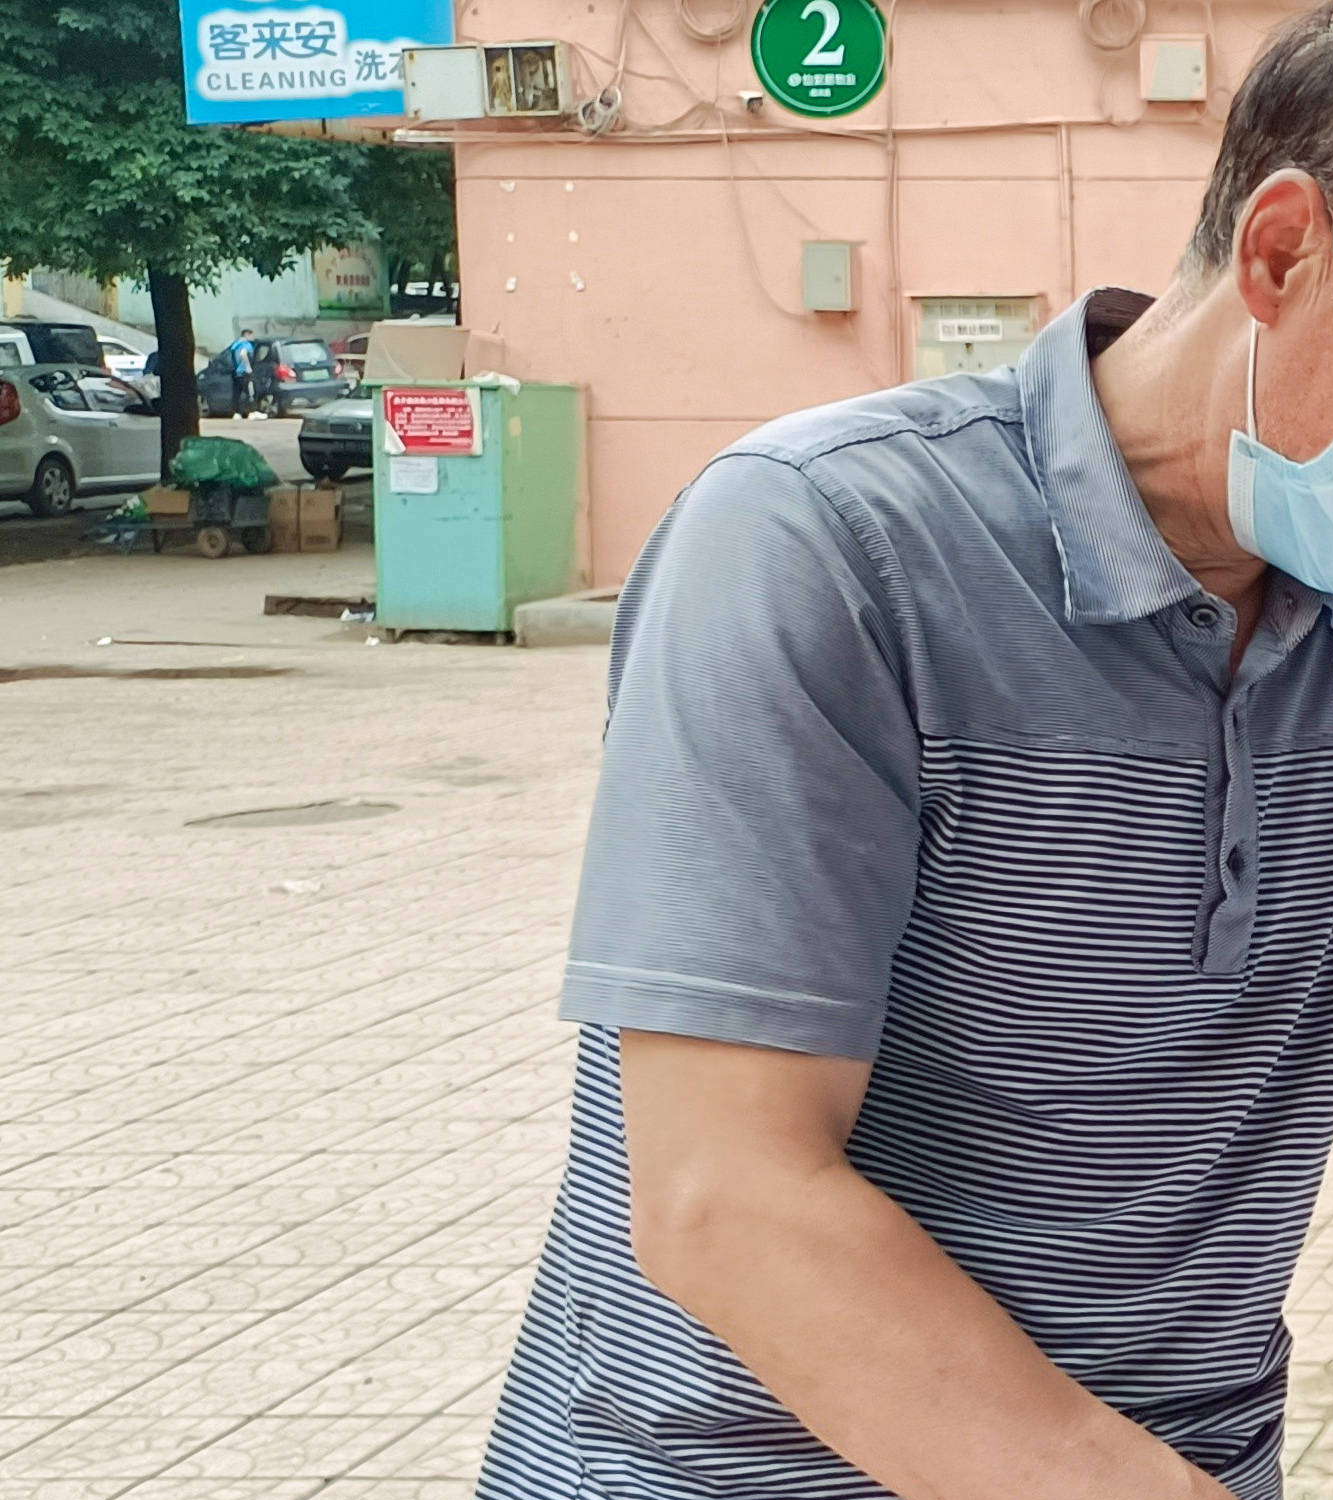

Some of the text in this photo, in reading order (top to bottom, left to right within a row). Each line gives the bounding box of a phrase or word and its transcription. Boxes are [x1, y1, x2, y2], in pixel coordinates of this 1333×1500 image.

[208, 18, 338, 61] 客来安
[800, 0, 844, 66] 2
[206, 69, 347, 92] CLEANING
